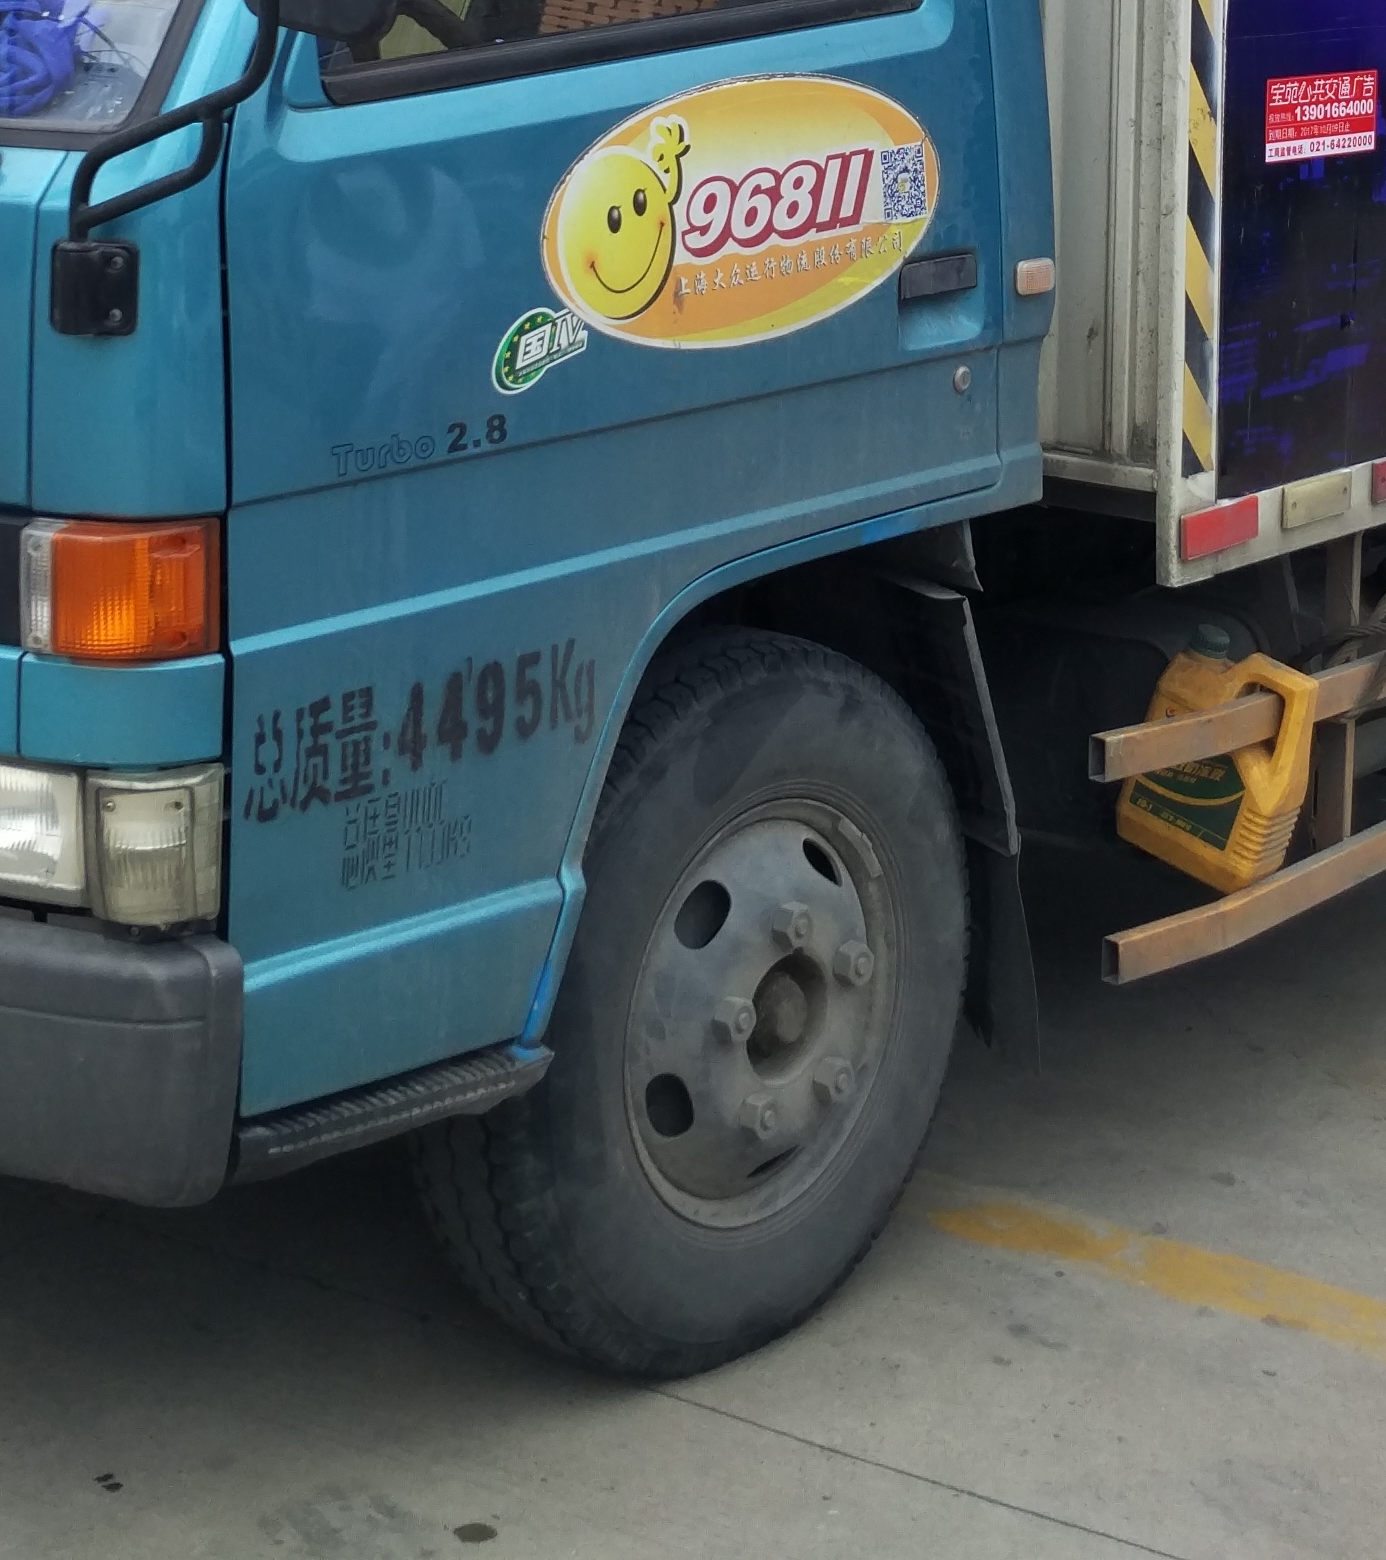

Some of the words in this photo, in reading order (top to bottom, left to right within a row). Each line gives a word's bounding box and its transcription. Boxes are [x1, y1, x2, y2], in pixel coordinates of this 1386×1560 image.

[1294, 99, 1373, 121] 13901664000
[680, 146, 875, 259] 96811
[447, 414, 508, 454] 2.8
